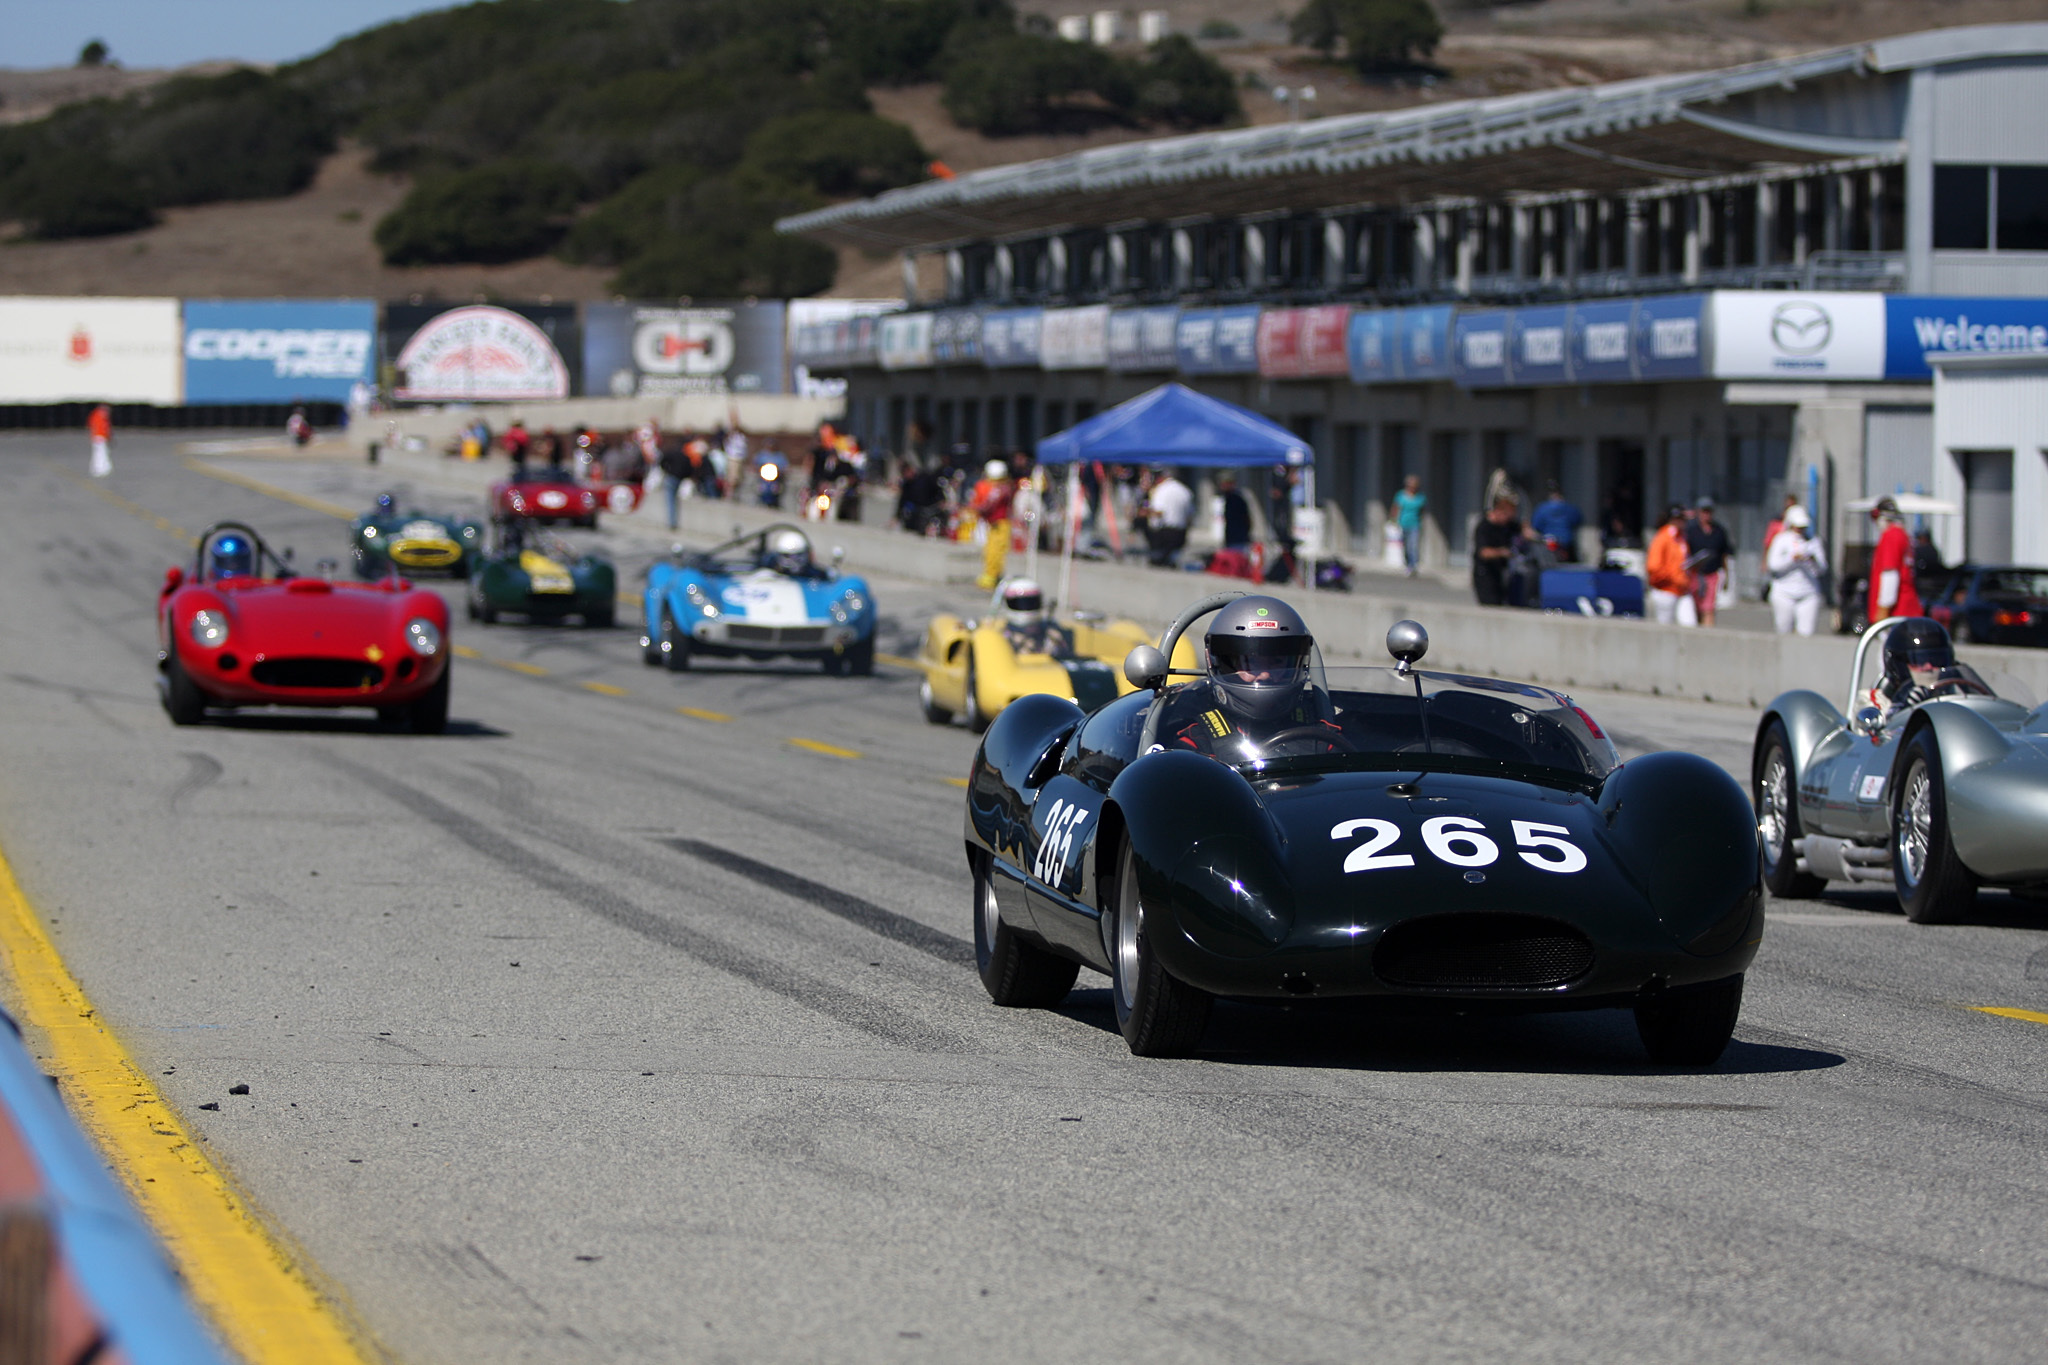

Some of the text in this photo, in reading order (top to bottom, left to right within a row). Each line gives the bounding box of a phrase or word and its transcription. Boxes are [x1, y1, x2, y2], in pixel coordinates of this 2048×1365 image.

[186, 329, 372, 360] COOPER
[1914, 315, 2048, 352] Welcome
[1034, 798, 1089, 889] 265
[1330, 816, 1587, 874] 265
